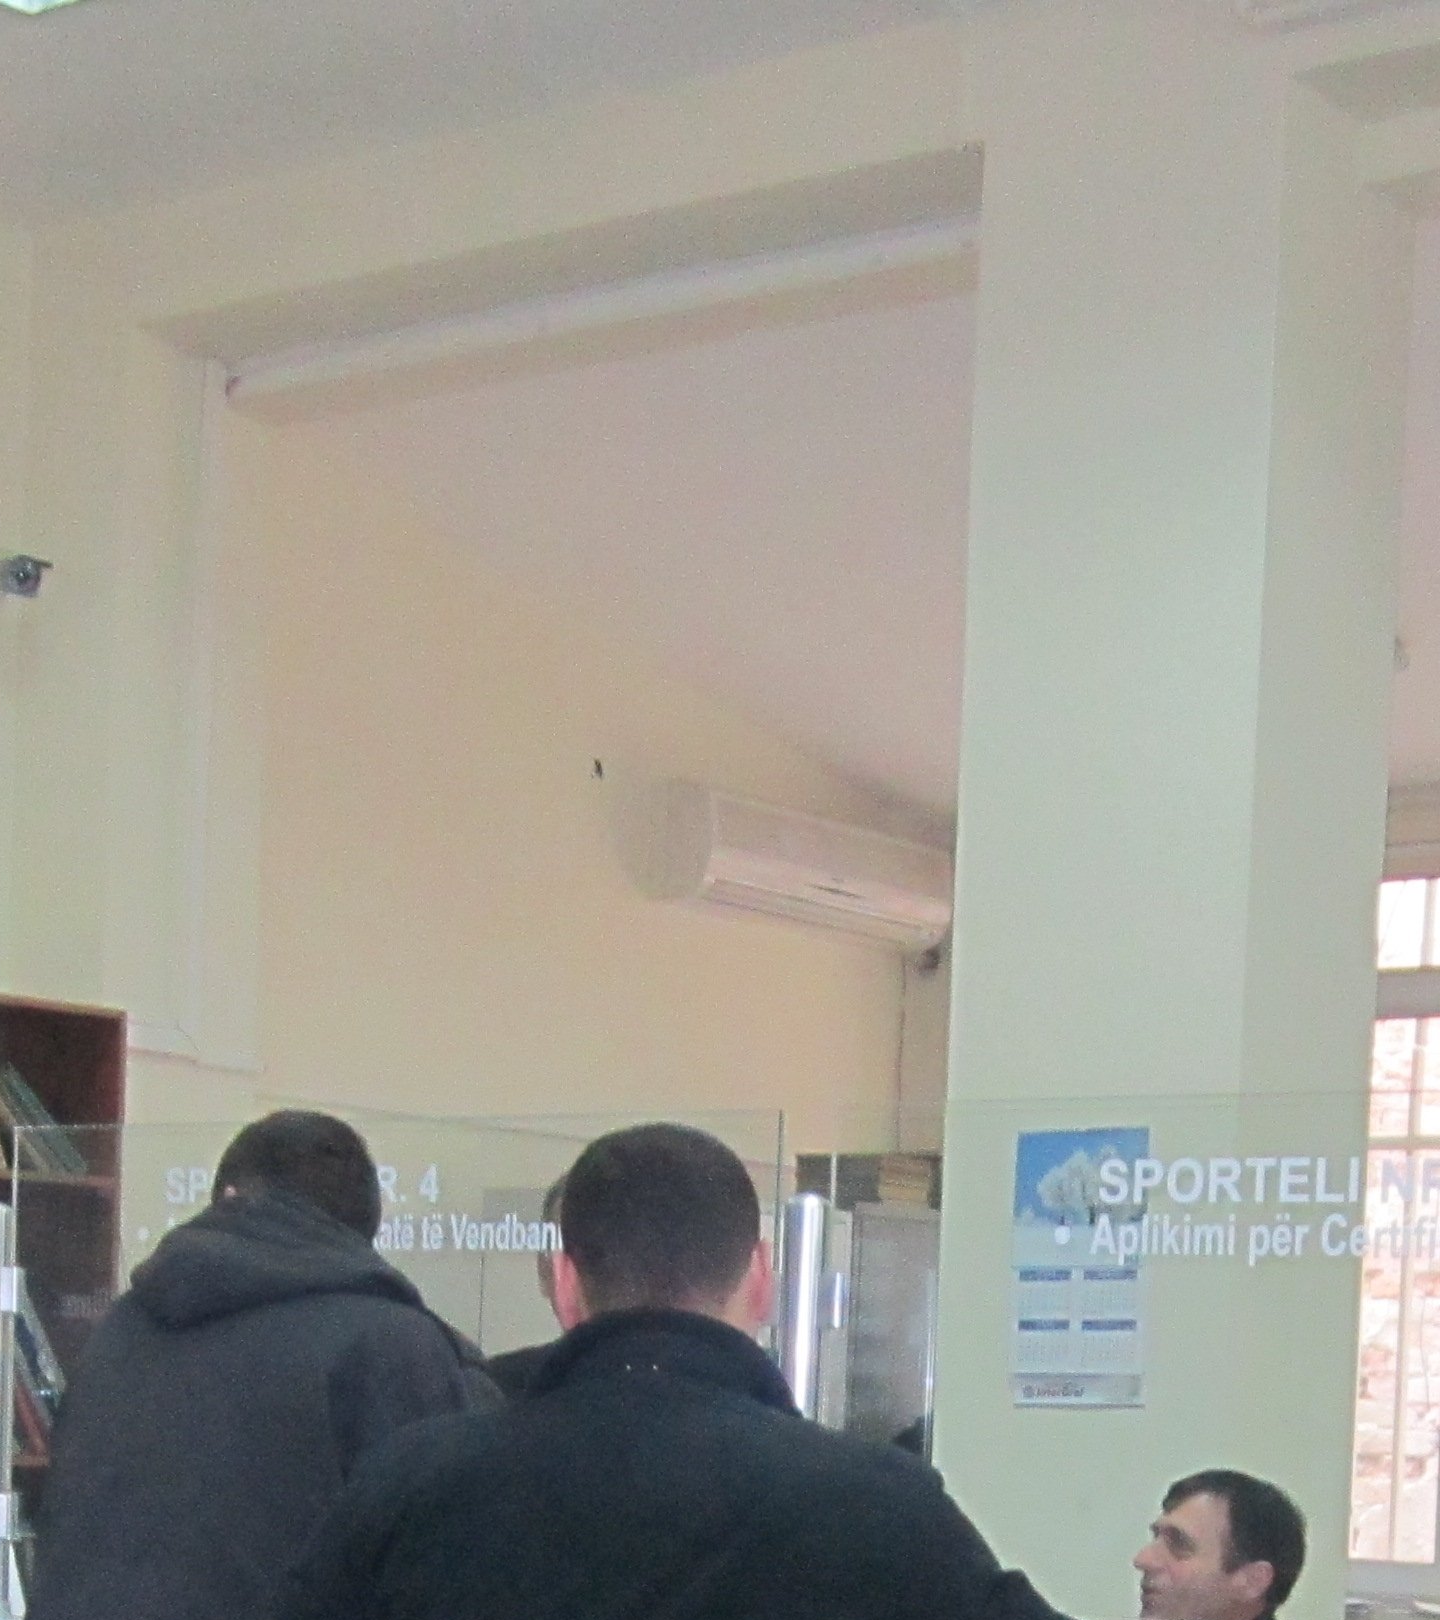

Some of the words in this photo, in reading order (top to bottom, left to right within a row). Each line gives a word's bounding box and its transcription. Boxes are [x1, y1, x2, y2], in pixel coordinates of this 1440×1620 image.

[418, 1163, 440, 1203] 4
[1098, 1156, 1361, 1206] SPORTELI
[421, 1214, 445, 1250] të
[1090, 1213, 1237, 1266] Aplikimi
[1248, 1213, 1310, 1267] për
